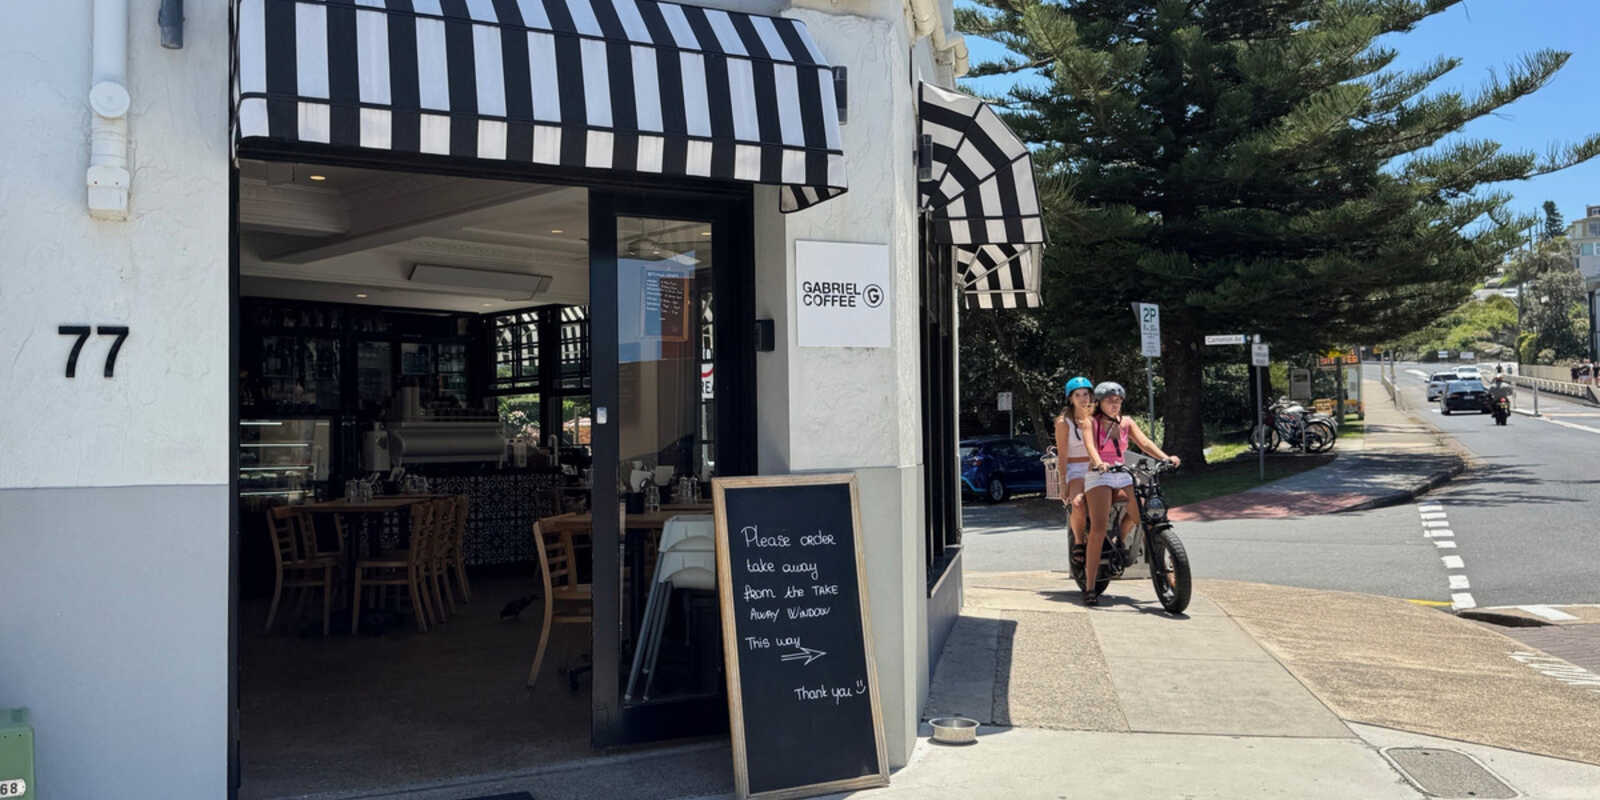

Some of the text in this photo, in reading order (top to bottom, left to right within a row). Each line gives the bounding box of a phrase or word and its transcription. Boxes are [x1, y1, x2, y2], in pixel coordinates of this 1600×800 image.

[802, 281, 861, 295] GABRIEL
[866, 286, 881, 305] G
[802, 294, 856, 307] COFFEE
[1143, 307, 1156, 322] 2P
[58, 325, 129, 378] 77
[741, 525, 791, 547] Please
[746, 558, 818, 580] take away
[744, 585, 839, 602] from the TAKE
[750, 608, 780, 623] AWAY
[745, 637, 801, 650] This way
[793, 684, 853, 705] Thank you
